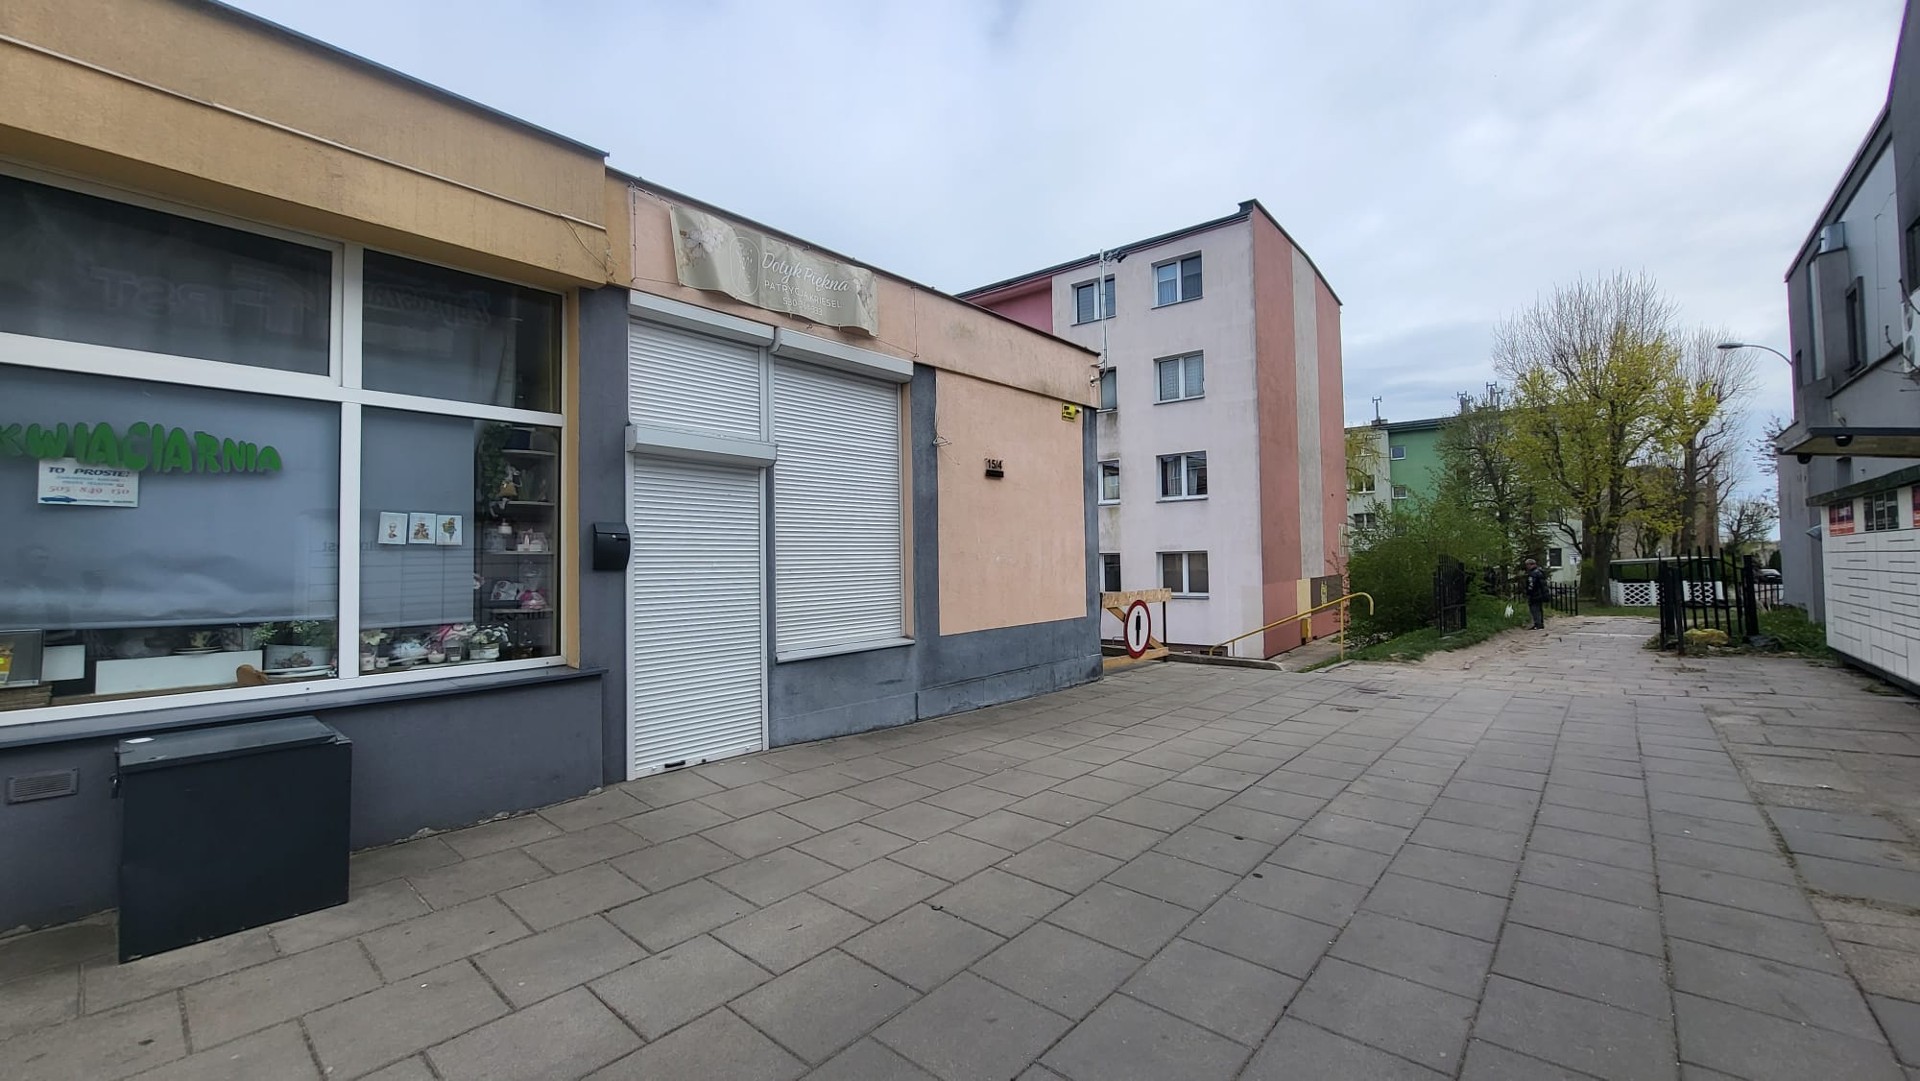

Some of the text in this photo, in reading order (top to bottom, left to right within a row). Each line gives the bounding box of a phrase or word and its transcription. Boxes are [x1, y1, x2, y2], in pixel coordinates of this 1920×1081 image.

[762, 252, 849, 292] Dotyk Piękna
[764, 279, 808, 298] PATRYCJA
[809, 293, 842, 308] KRIESEL
[0, 421, 283, 474] KWIACIARNIA
[49, 466, 65, 474] TO
